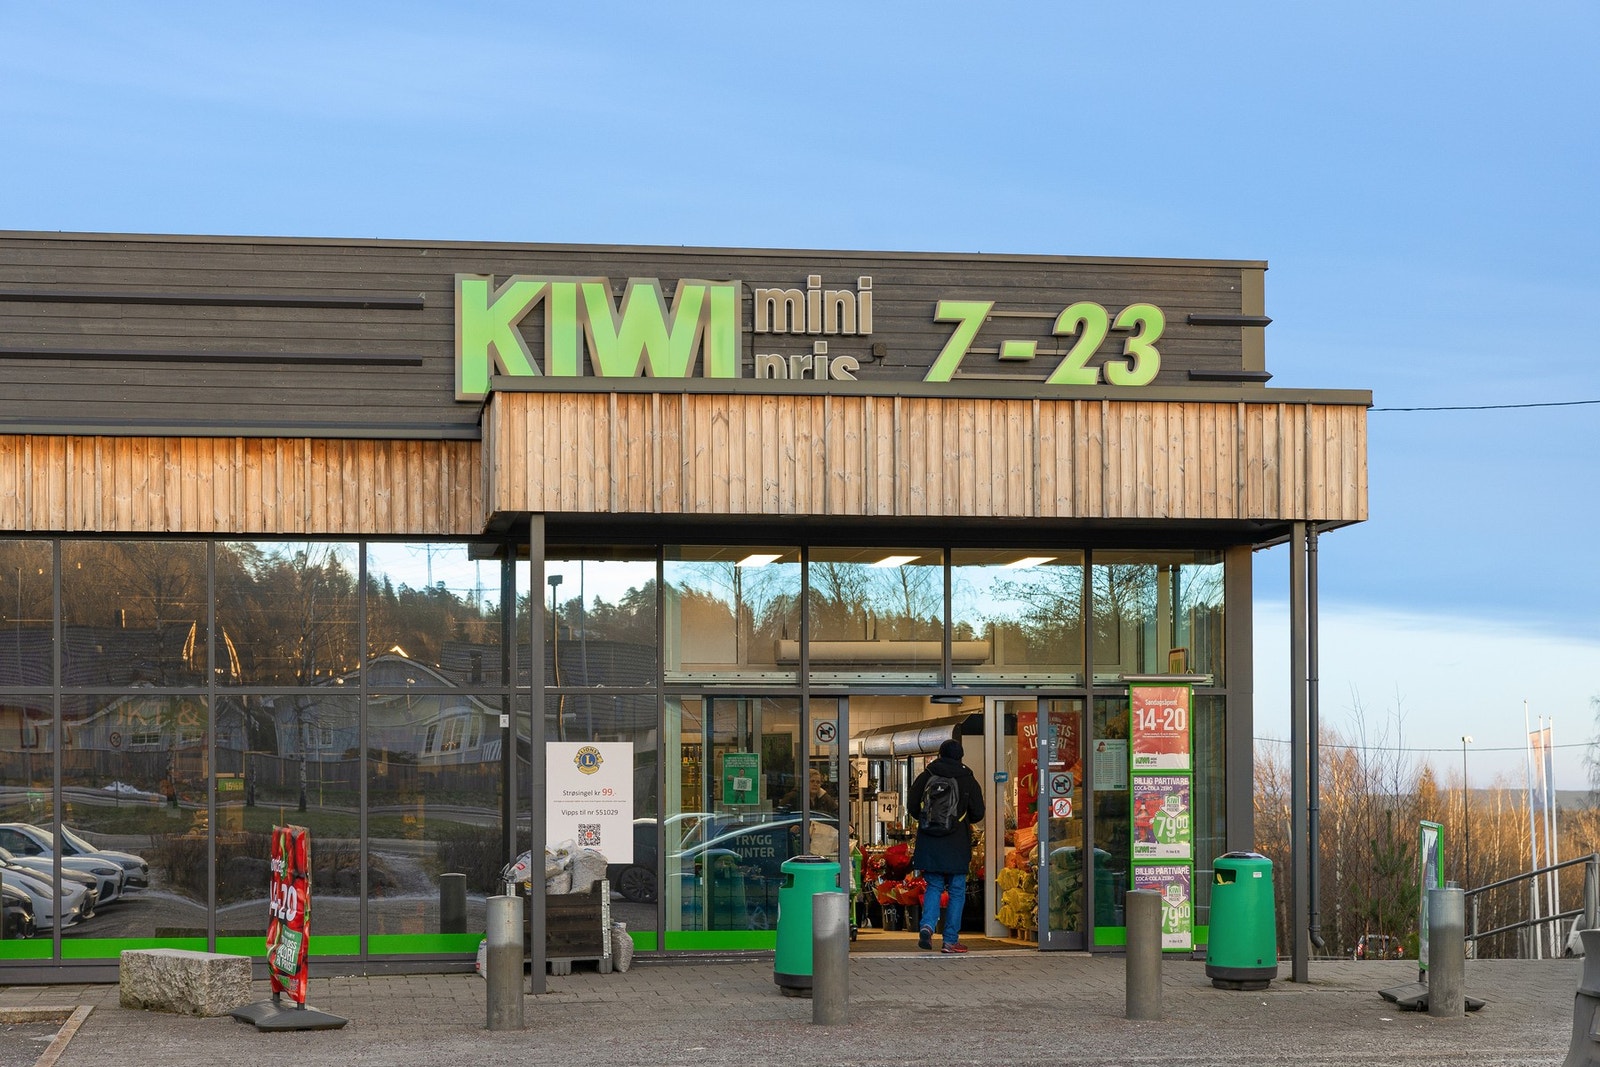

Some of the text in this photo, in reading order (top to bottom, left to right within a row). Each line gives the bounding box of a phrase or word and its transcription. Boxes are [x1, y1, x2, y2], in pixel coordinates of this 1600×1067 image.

[754, 275, 872, 335] mini
[455, 273, 742, 401] KIWI
[1136, 707, 1186, 731] 14-20
[1134, 777, 1153, 785] BILLIG
[561, 809, 578, 817] Vipps
[735, 834, 772, 846] TRYGG
[1135, 867, 1154, 875] BILLIG
